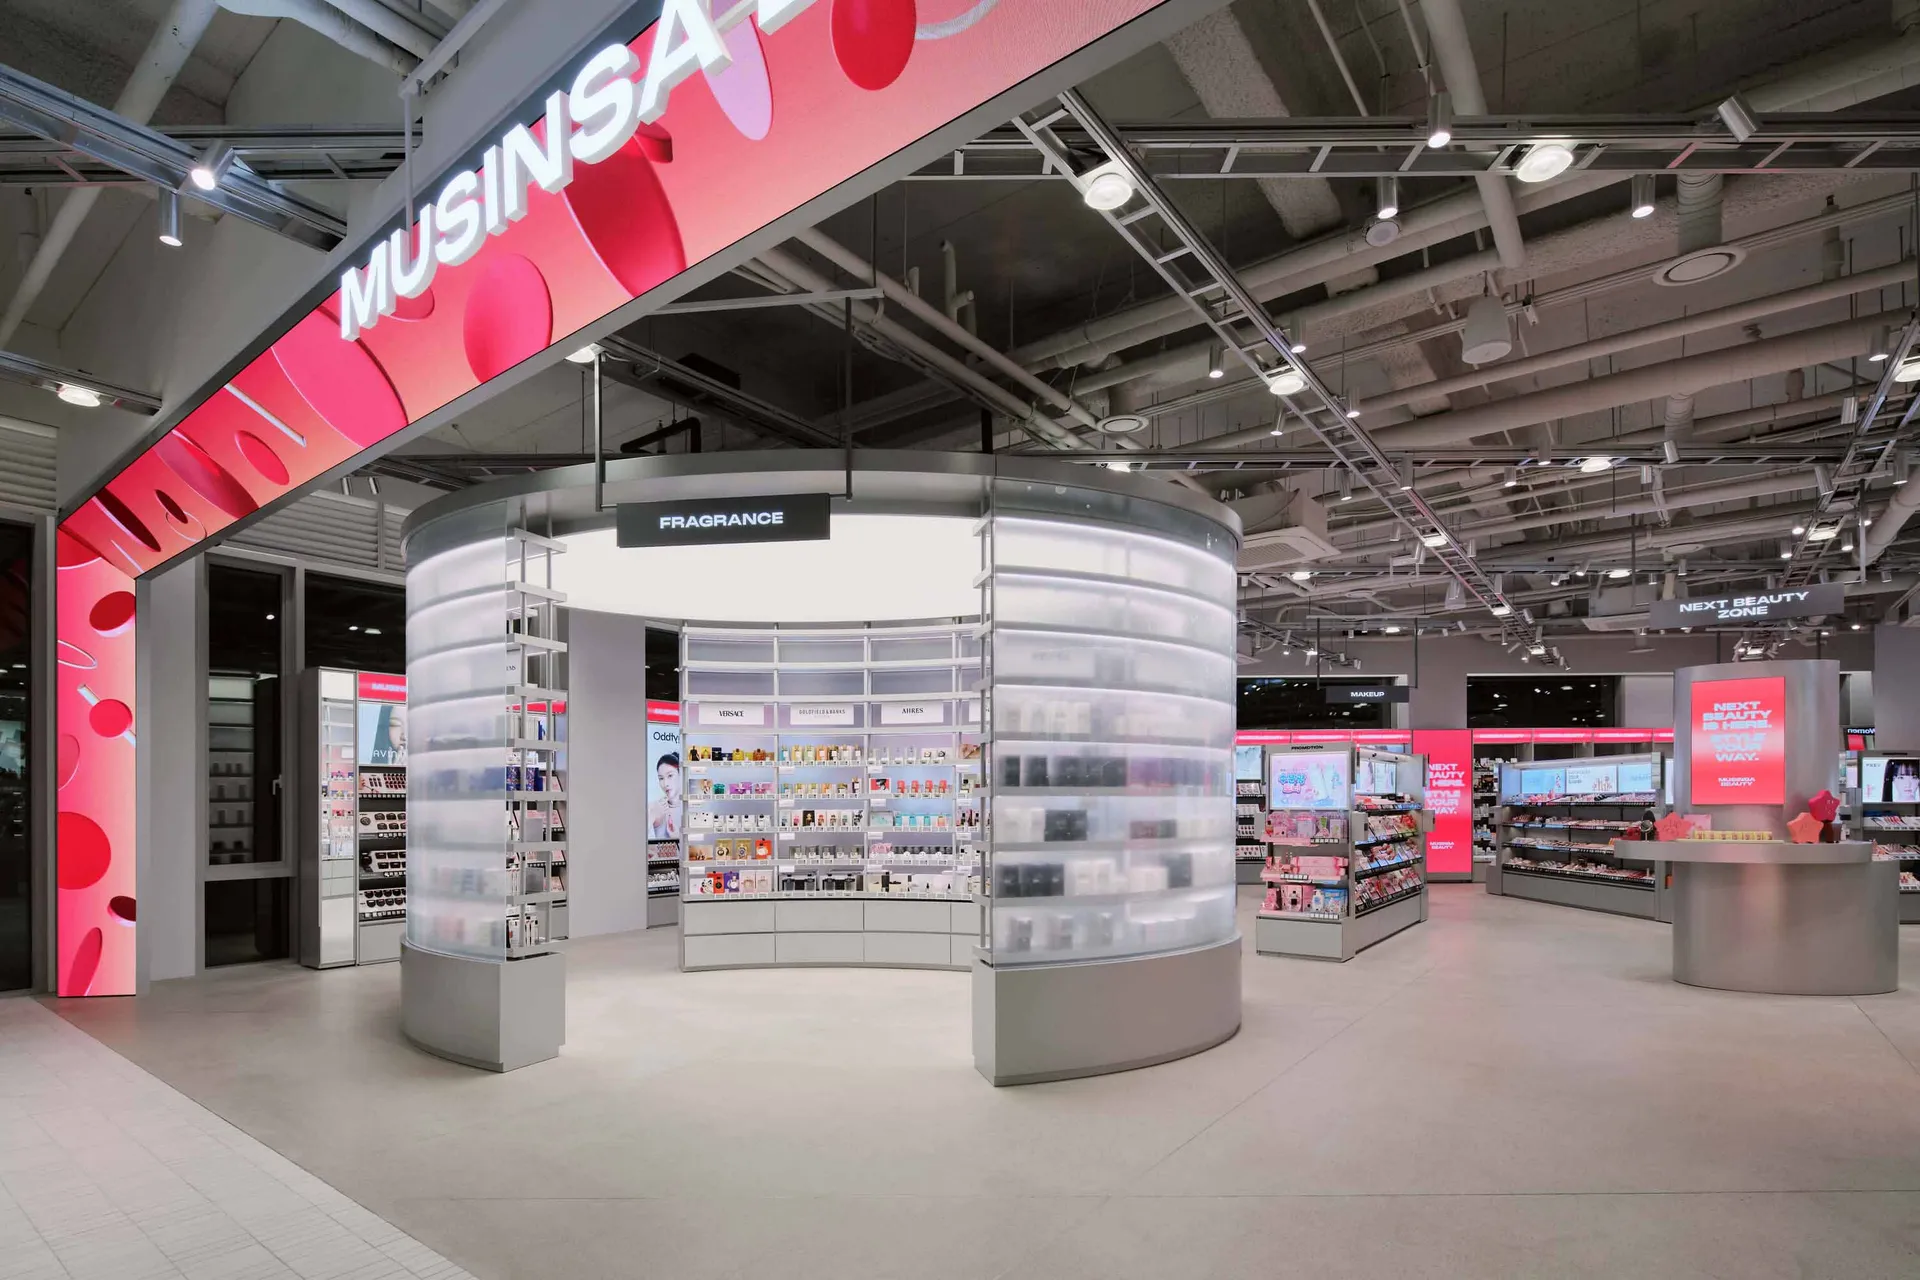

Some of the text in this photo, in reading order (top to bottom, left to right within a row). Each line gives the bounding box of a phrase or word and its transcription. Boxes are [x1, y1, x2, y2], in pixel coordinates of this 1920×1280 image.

[340, 0, 732, 341] MUSINSA
[659, 511, 784, 529] FRAGRANCE
[1679, 591, 1810, 613] NEXT BEAUTY
[1717, 605, 1769, 619] ZONE
[1713, 701, 1761, 711] NEXT
[1702, 710, 1772, 721] BEAUTY
[1715, 752, 1760, 762] WAY.
